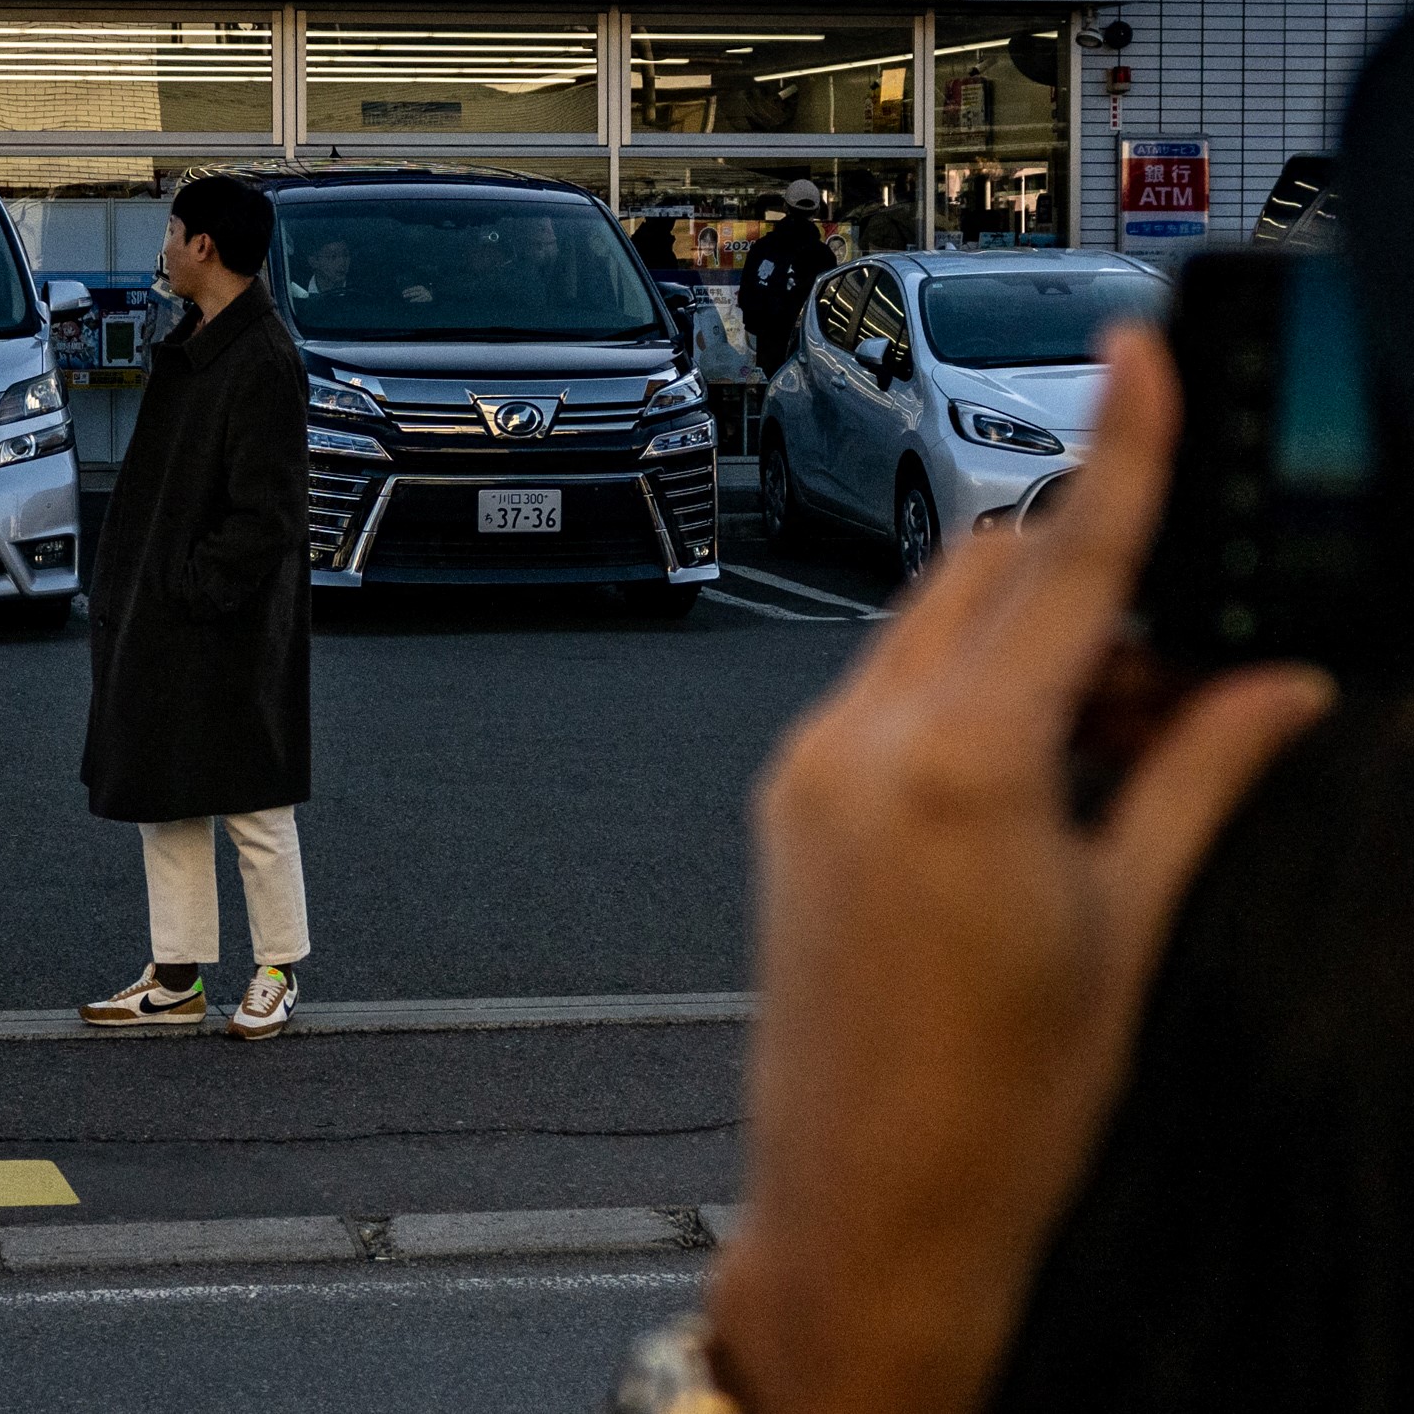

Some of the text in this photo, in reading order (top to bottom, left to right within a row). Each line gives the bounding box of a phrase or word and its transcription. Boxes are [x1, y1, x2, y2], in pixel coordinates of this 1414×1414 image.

[1136, 143, 1197, 155] ATMサービス
[1144, 164, 1191, 184] 銀行
[1138, 187, 1193, 206] ATM
[131, 290, 148, 305] SPY
[498, 493, 544, 505] 川口 300
[497, 507, 557, 529] 37-36
